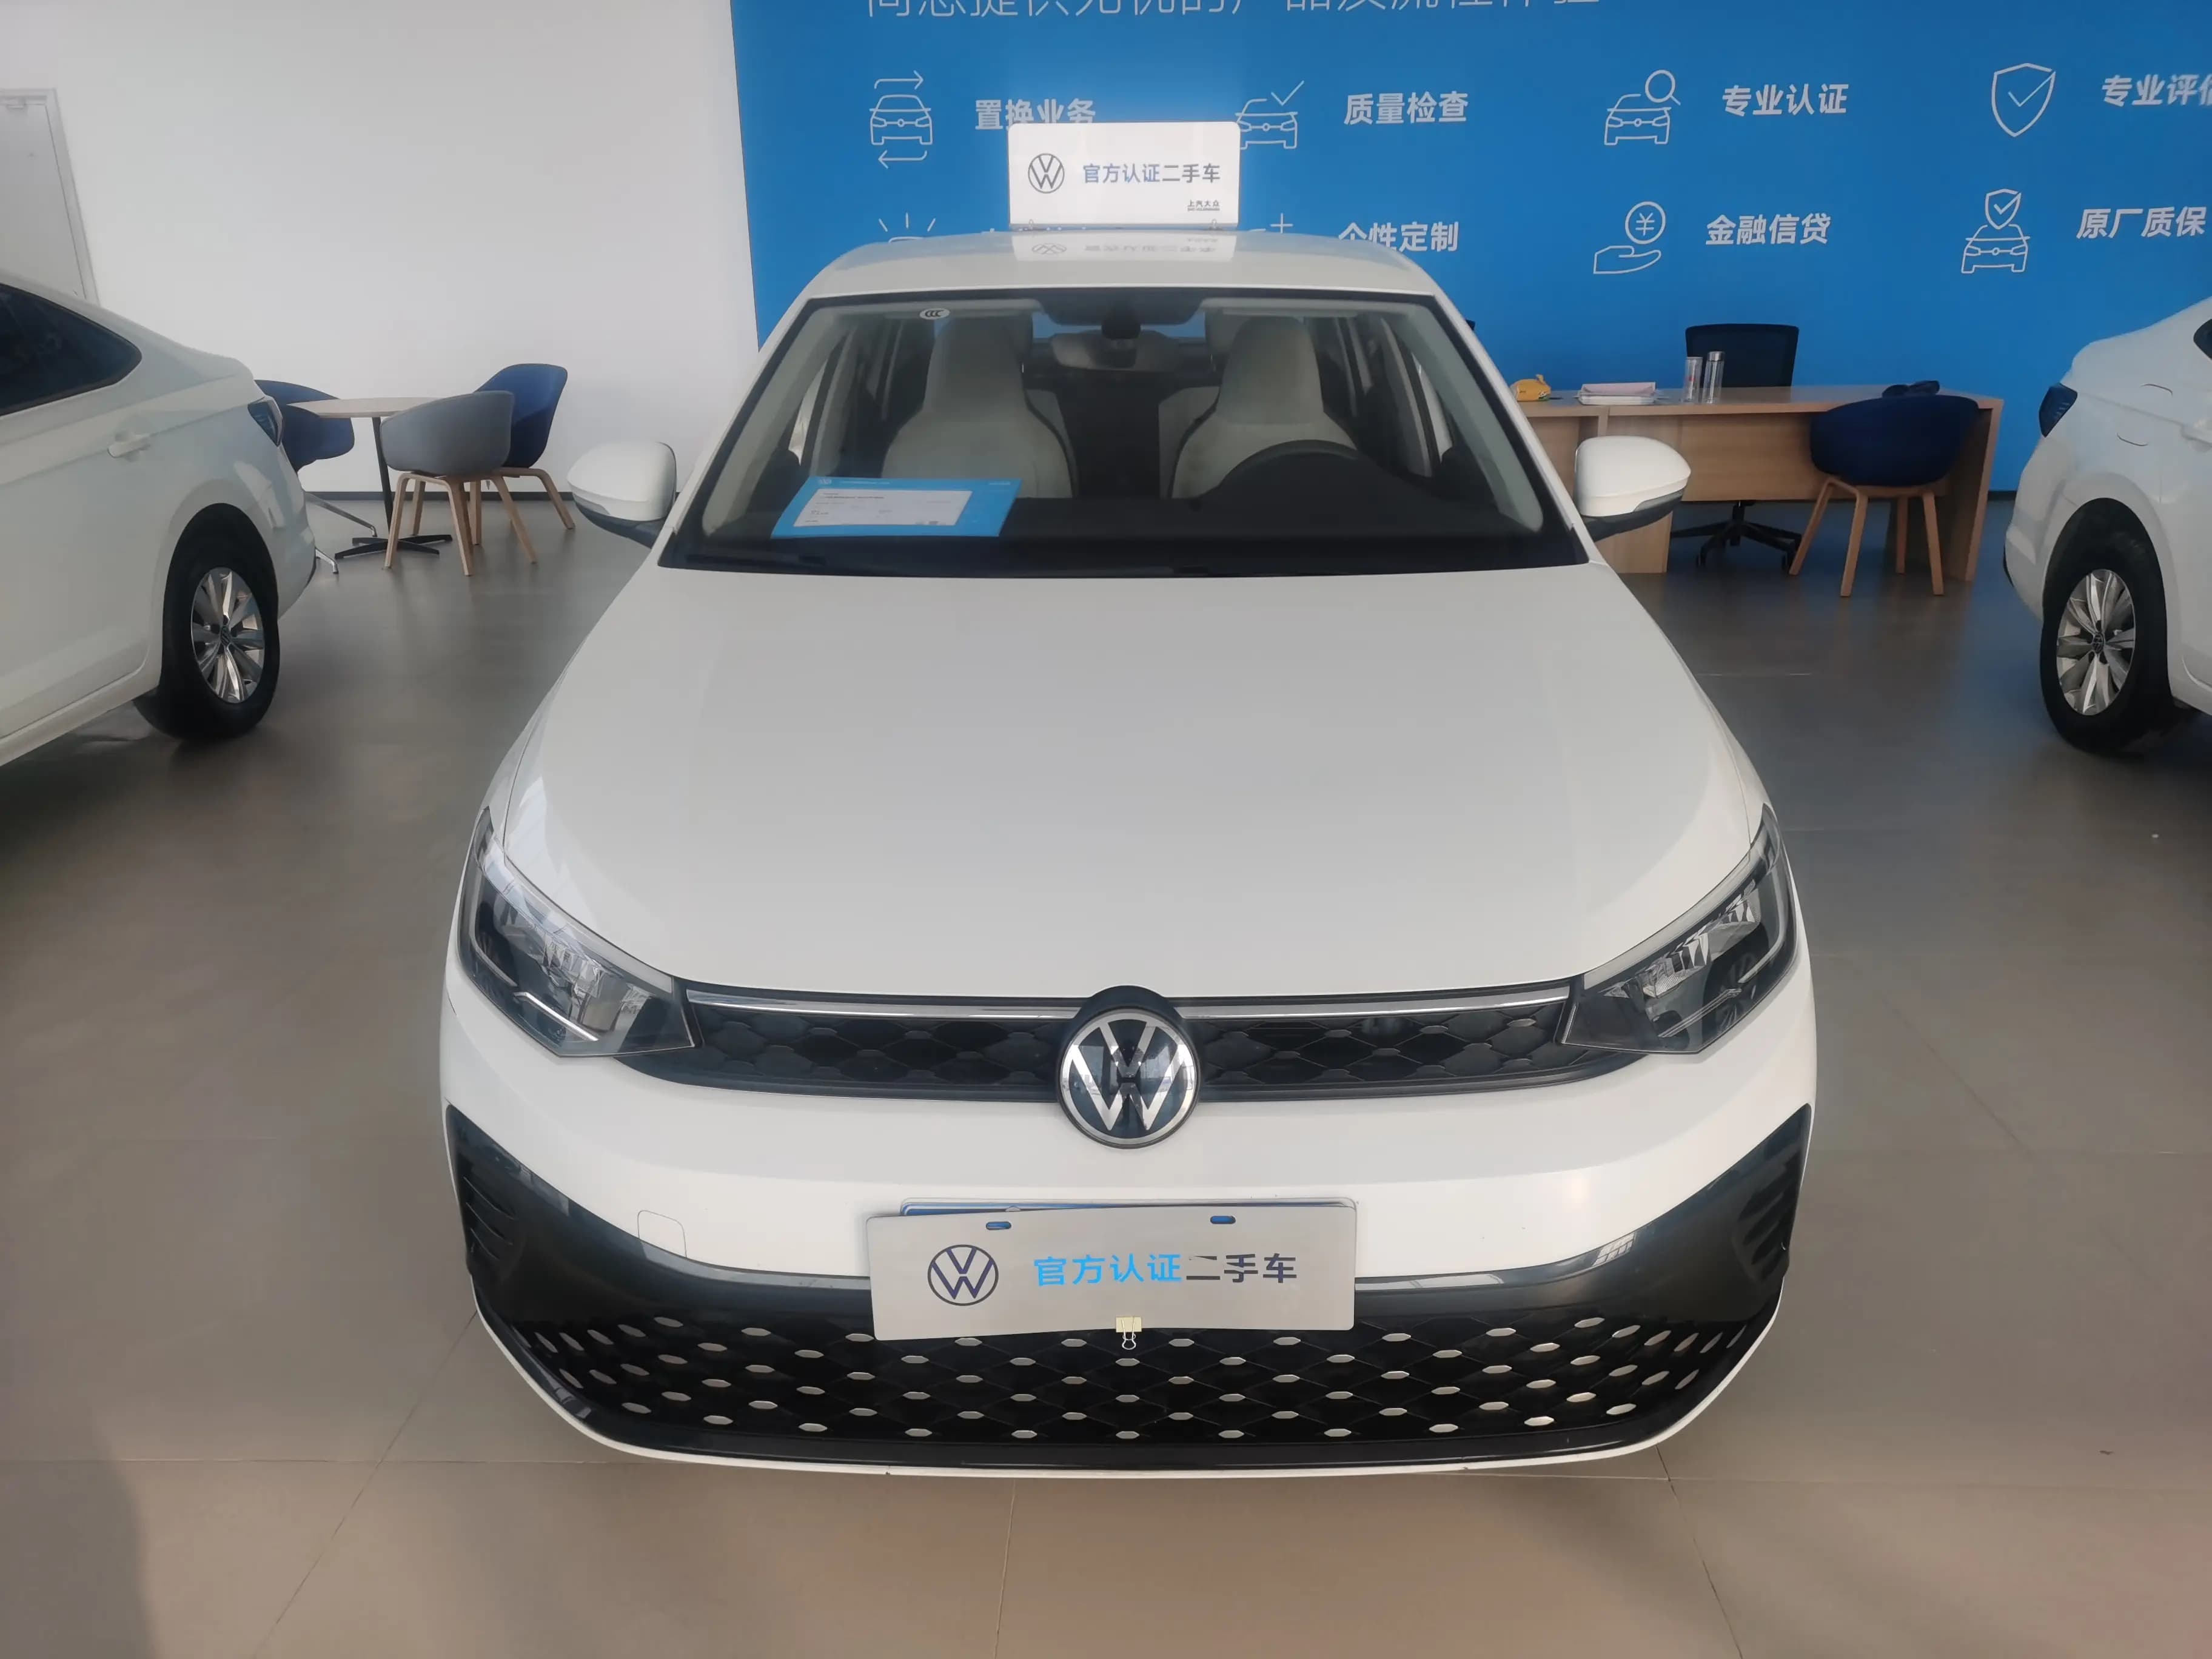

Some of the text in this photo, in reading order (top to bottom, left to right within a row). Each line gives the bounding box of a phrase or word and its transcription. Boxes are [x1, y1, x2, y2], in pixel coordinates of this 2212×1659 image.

[975, 98, 1096, 131] 置换业务
[1343, 91, 1469, 125] 质量检查
[1722, 83, 1849, 117] 专业认证
[1028, 153, 1065, 193] VW
[1083, 163, 1221, 184] 官方认证二手车
[1706, 213, 1832, 245] 金融信贷
[2076, 206, 2207, 240] 原厂质保
[1061, 1009, 1197, 1145] VW
[928, 1244, 999, 1306] VW
[1033, 1252, 1298, 1287] 官方认证二手车
